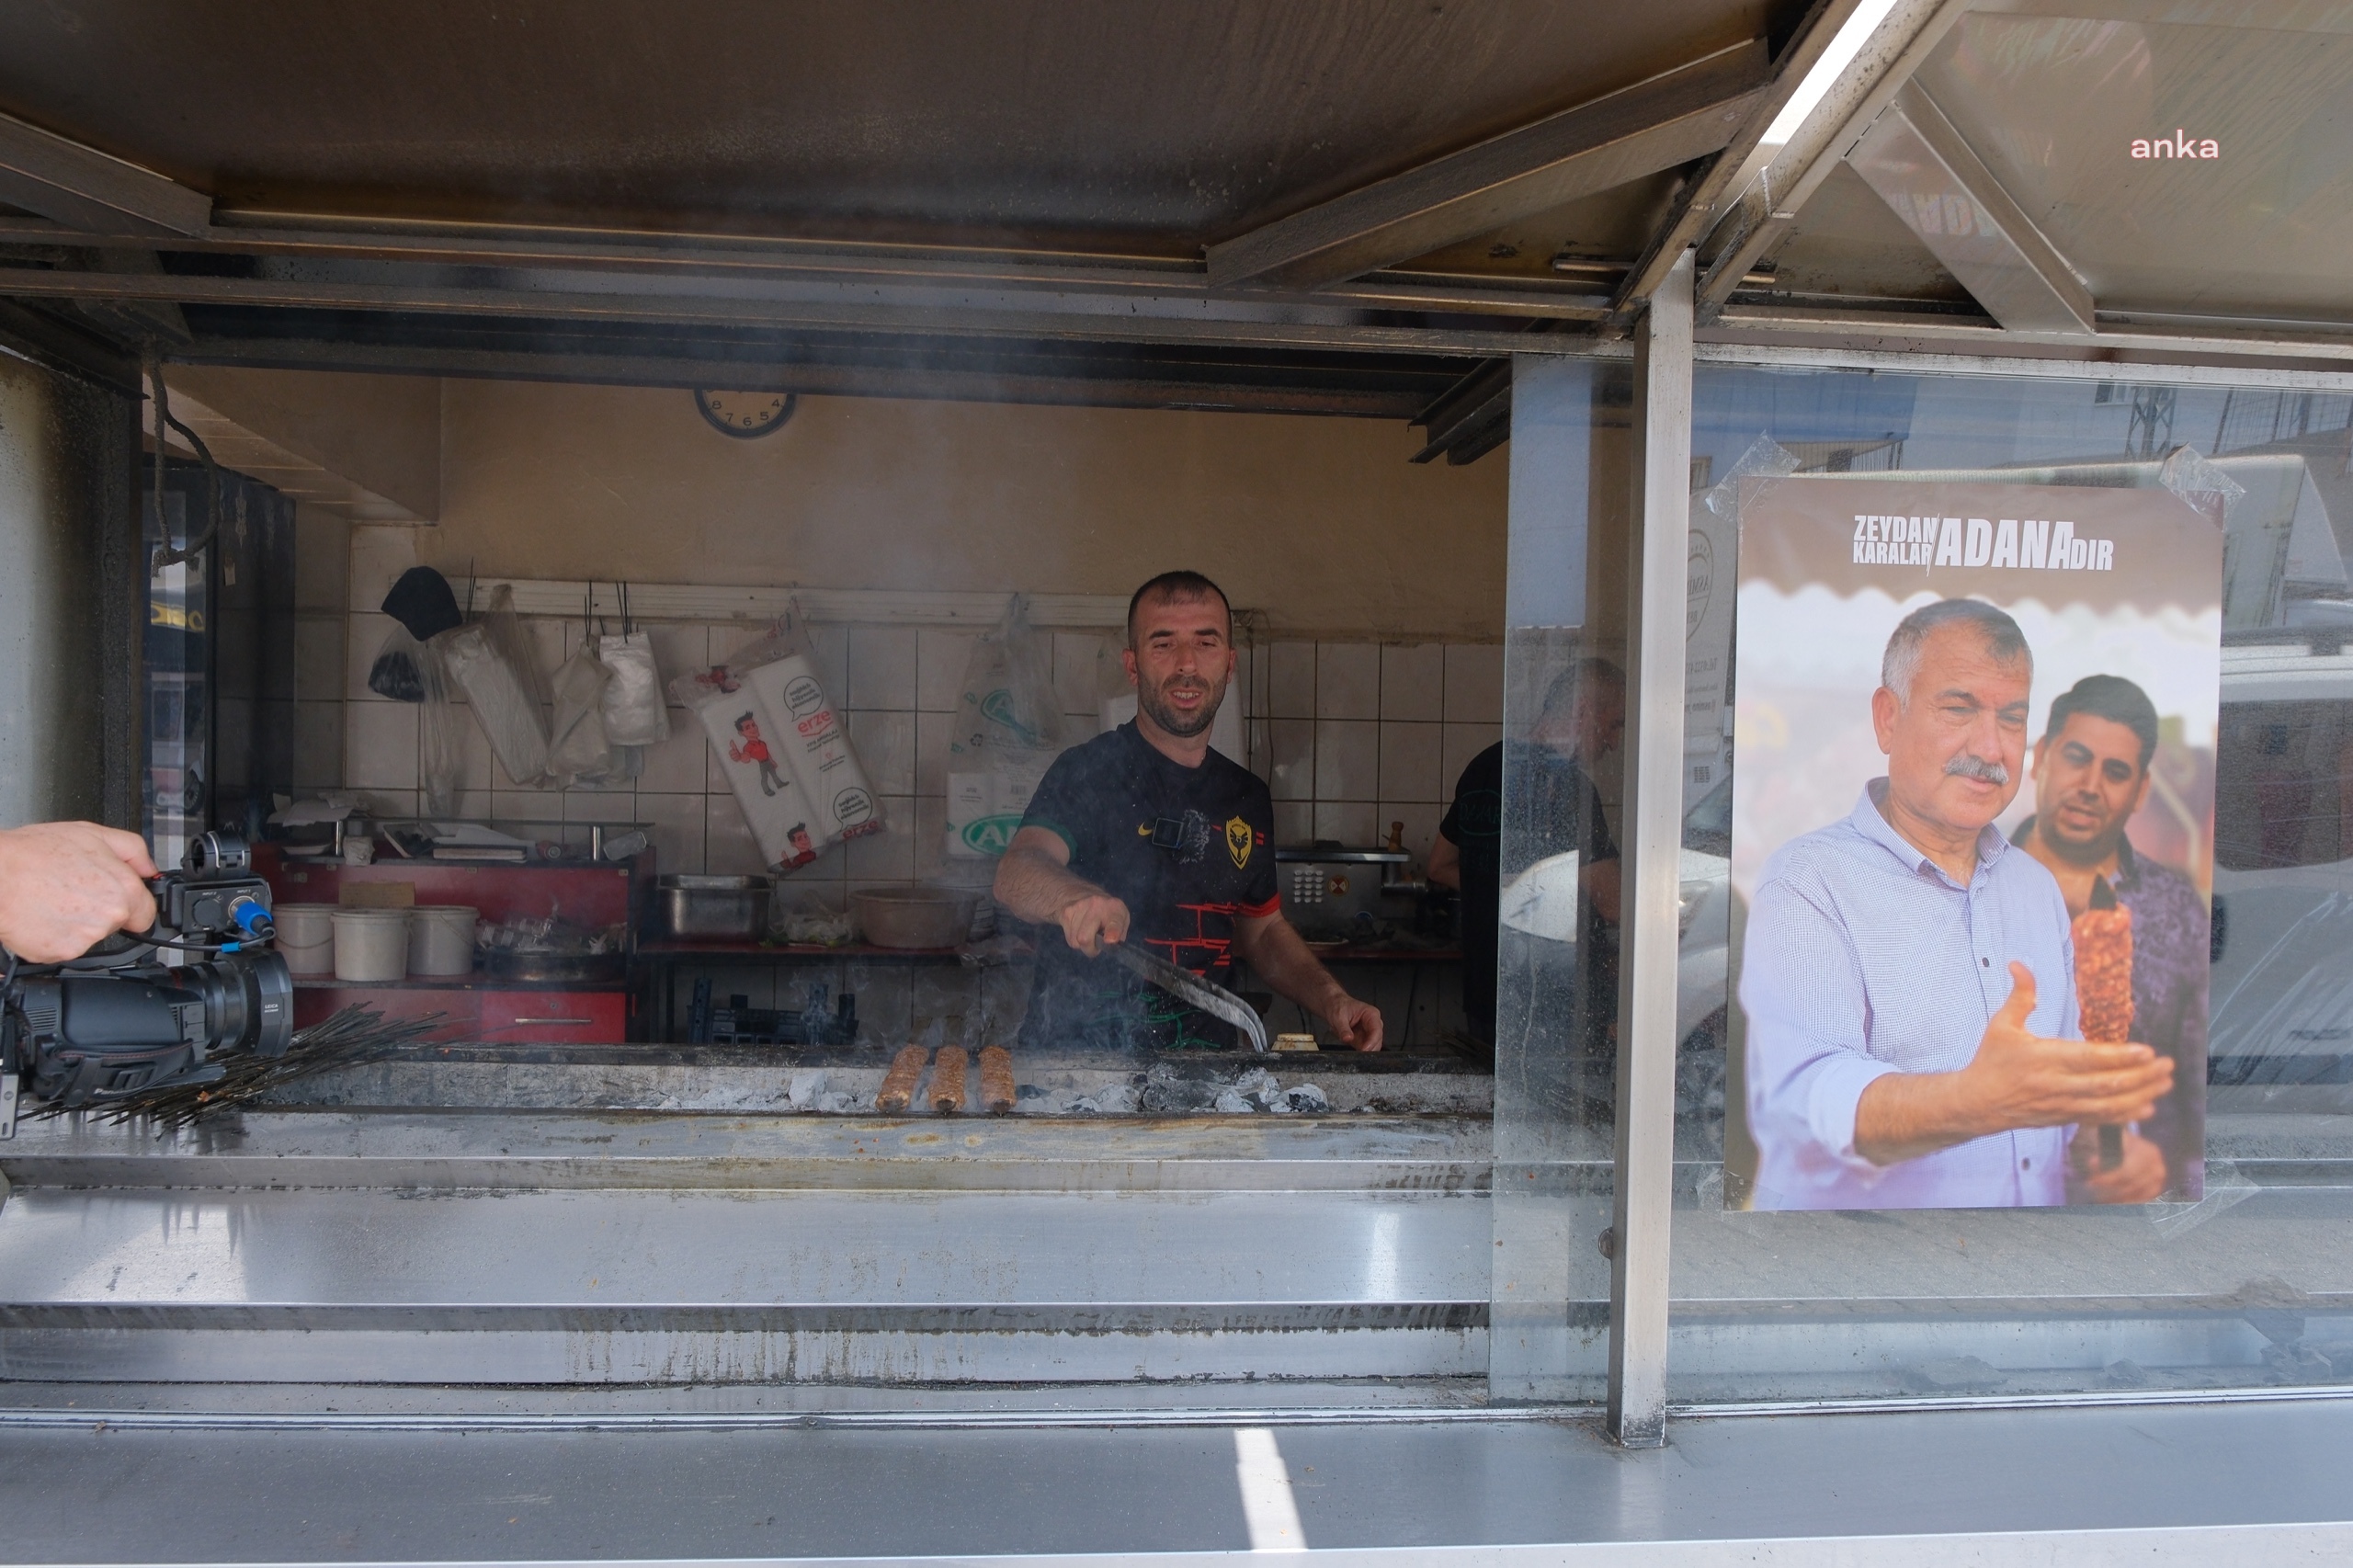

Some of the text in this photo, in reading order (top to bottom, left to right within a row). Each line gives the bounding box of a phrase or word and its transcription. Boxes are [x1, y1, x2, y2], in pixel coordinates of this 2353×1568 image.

[711, 400, 722, 410] 8
[771, 398, 780, 408] 4
[725, 413, 733, 423] 7
[743, 416, 753, 426] 6
[759, 411, 769, 421] 5
[1853, 515, 1940, 543] ZEYDAN
[1852, 540, 1934, 565] KARALAR
[798, 710, 831, 733] erze
[843, 820, 878, 839] erze
